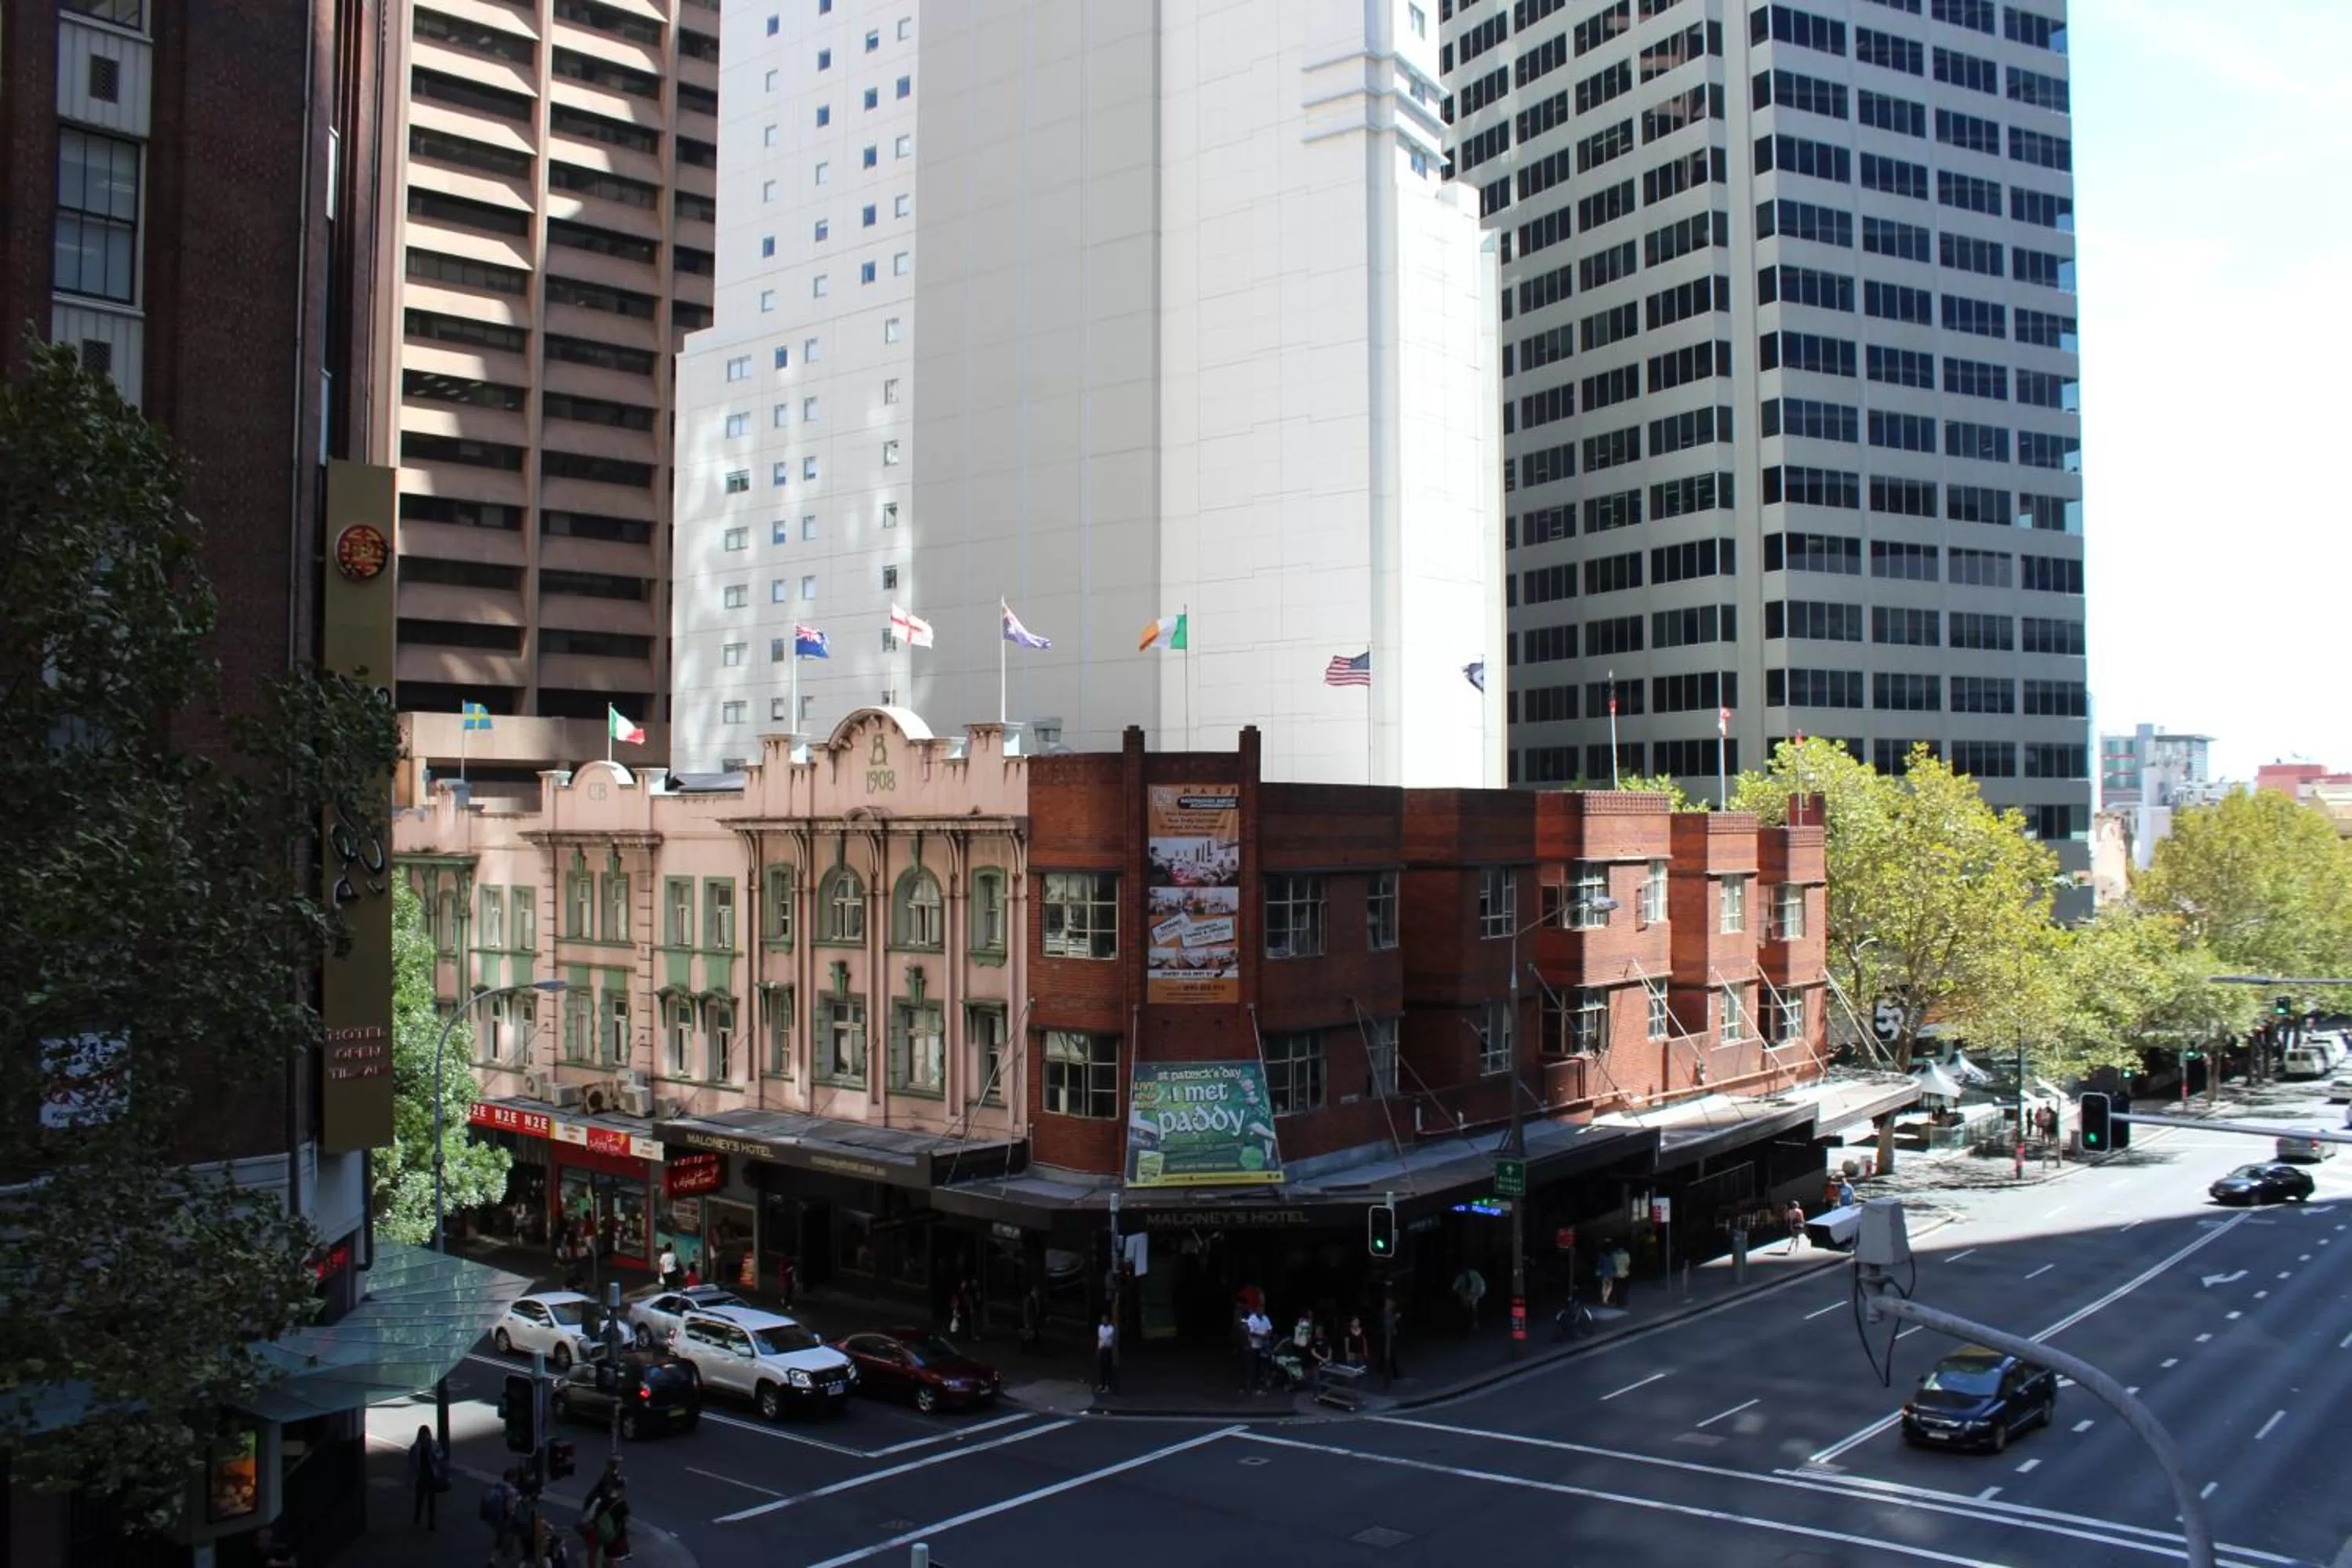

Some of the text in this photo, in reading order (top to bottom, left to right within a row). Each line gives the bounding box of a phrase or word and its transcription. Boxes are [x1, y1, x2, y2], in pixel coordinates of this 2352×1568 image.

[866, 769, 896, 794] 1908
[326, 1025, 387, 1042] HOTEL
[1185, 1083, 1229, 1101] met
[470, 1103, 487, 1118] 2E
[494, 1108, 517, 1124] N2E
[524, 1113, 548, 1131] N2E
[1158, 1104, 1244, 1141] paddy
[741, 1142, 775, 1158] HOTEL
[1145, 1210, 1311, 1226] MALONEY'S HOTEL
